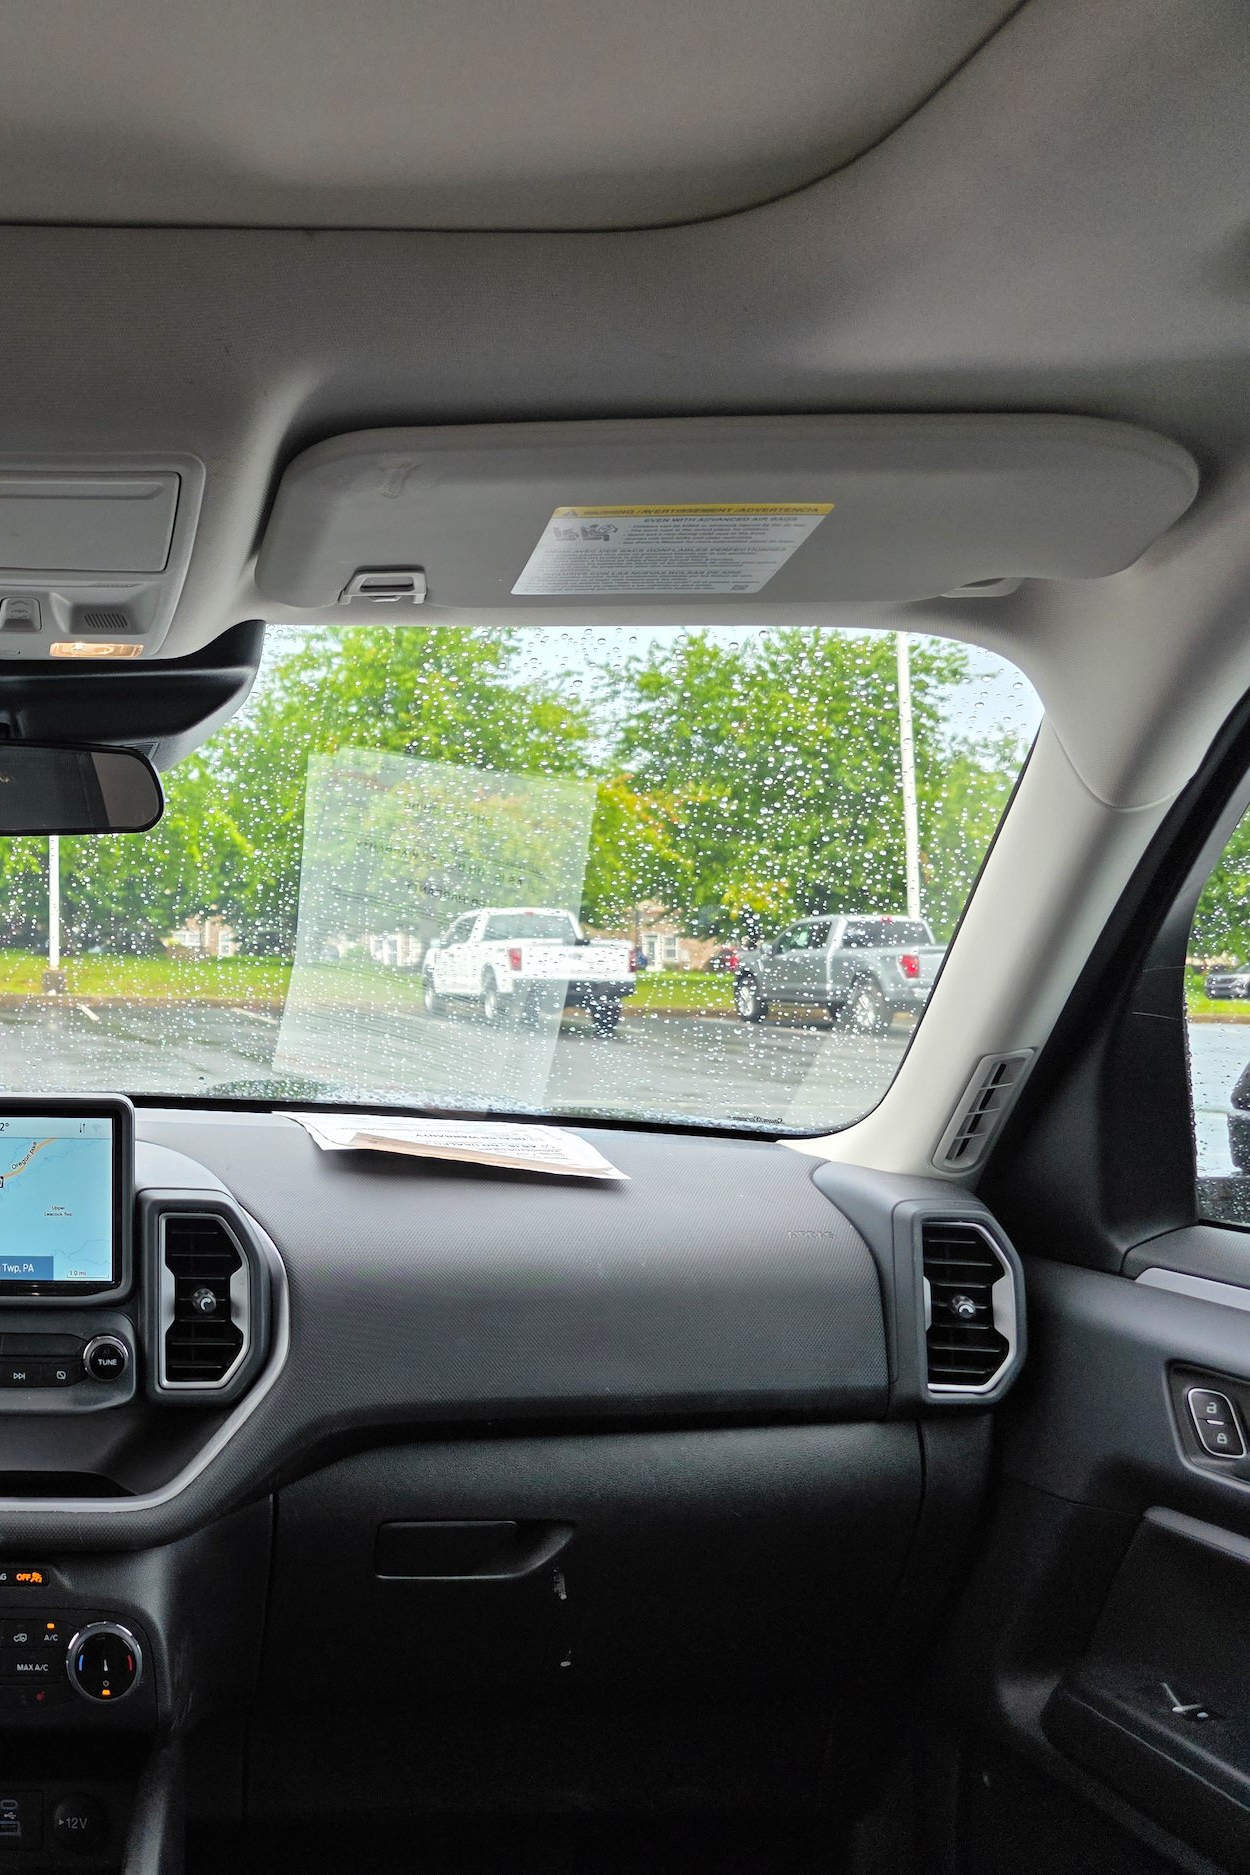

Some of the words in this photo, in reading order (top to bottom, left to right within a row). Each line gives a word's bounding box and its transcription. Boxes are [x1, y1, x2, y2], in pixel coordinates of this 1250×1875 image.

[11, 1152, 31, 1170] Oregon
[2, 1263, 22, 1274] Twp,
[23, 1263, 35, 1273] PA
[97, 1358, 118, 1366] TUNE
[15, 1572, 32, 1582] OFF
[43, 1633, 59, 1643] A/C
[16, 1663, 33, 1672] MAX
[34, 1663, 49, 1672] A/C
[65, 1817, 88, 1830] 12V
